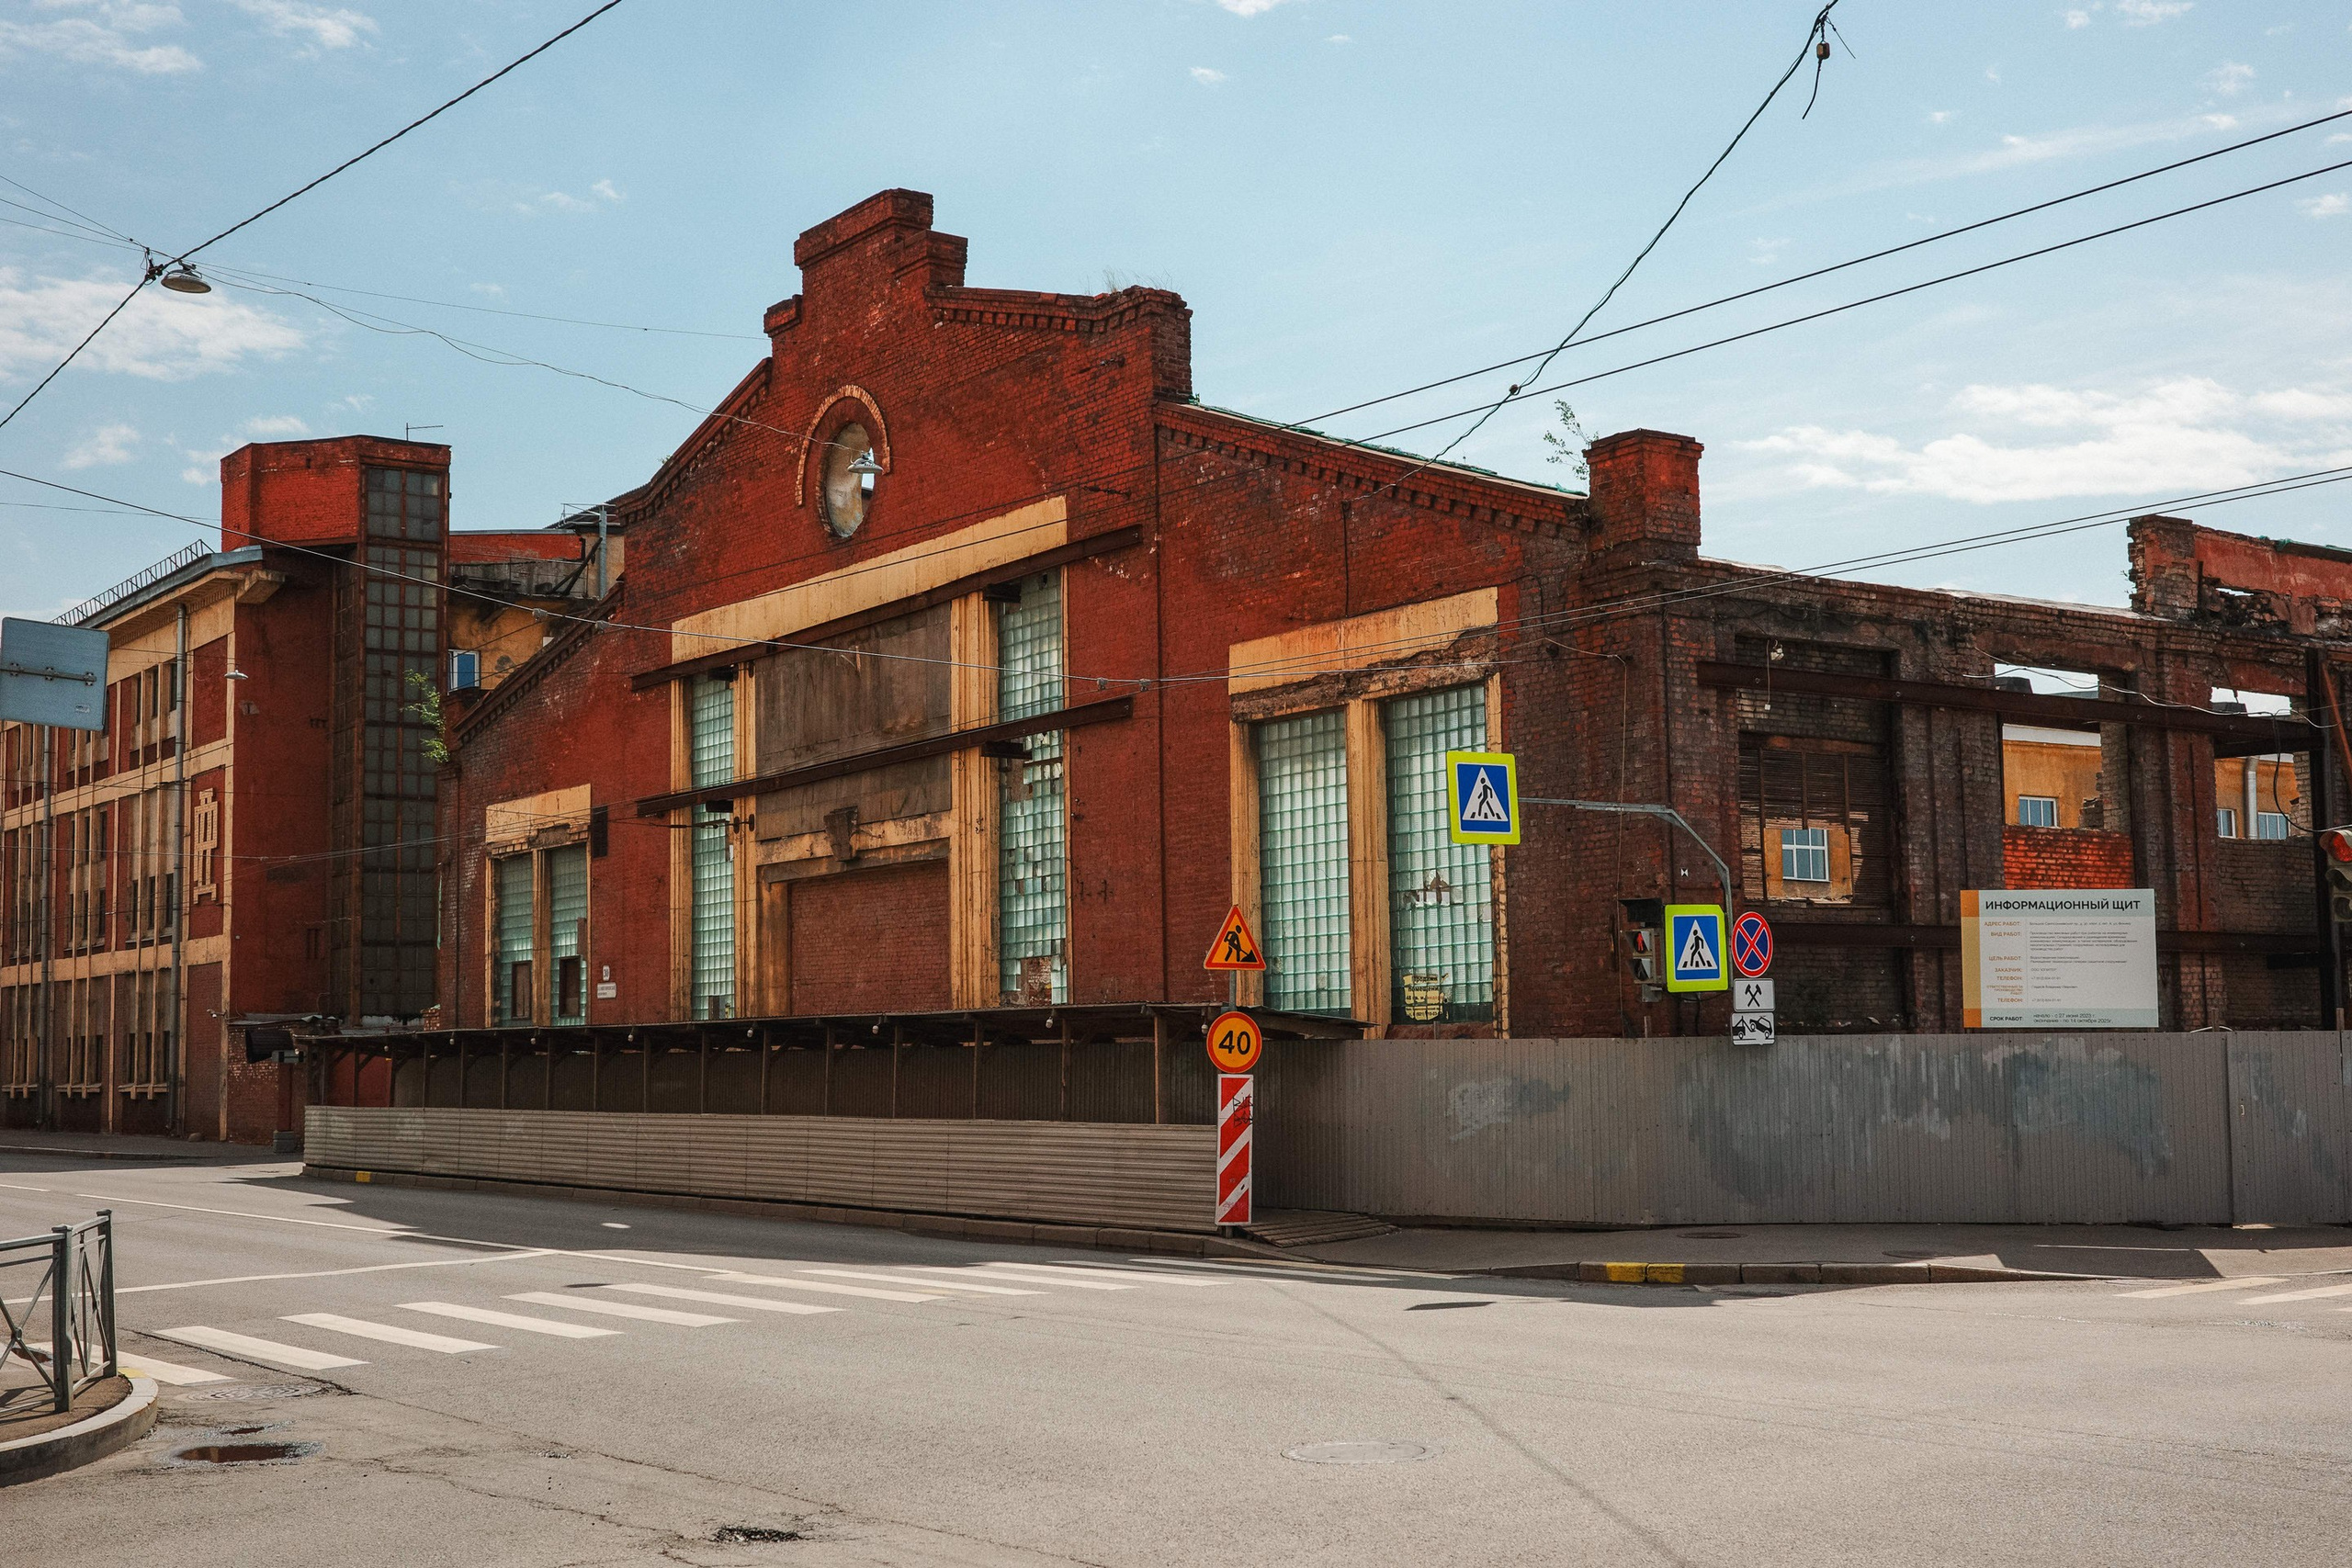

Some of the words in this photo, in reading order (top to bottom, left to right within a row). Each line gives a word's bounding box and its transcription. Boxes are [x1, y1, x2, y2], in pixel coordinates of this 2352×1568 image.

[1985, 897, 2109, 911] ИНФОРМАЦИОННЫЙ
[2112, 900, 2141, 911] ЩИТ
[1218, 1030, 1250, 1055] 40
